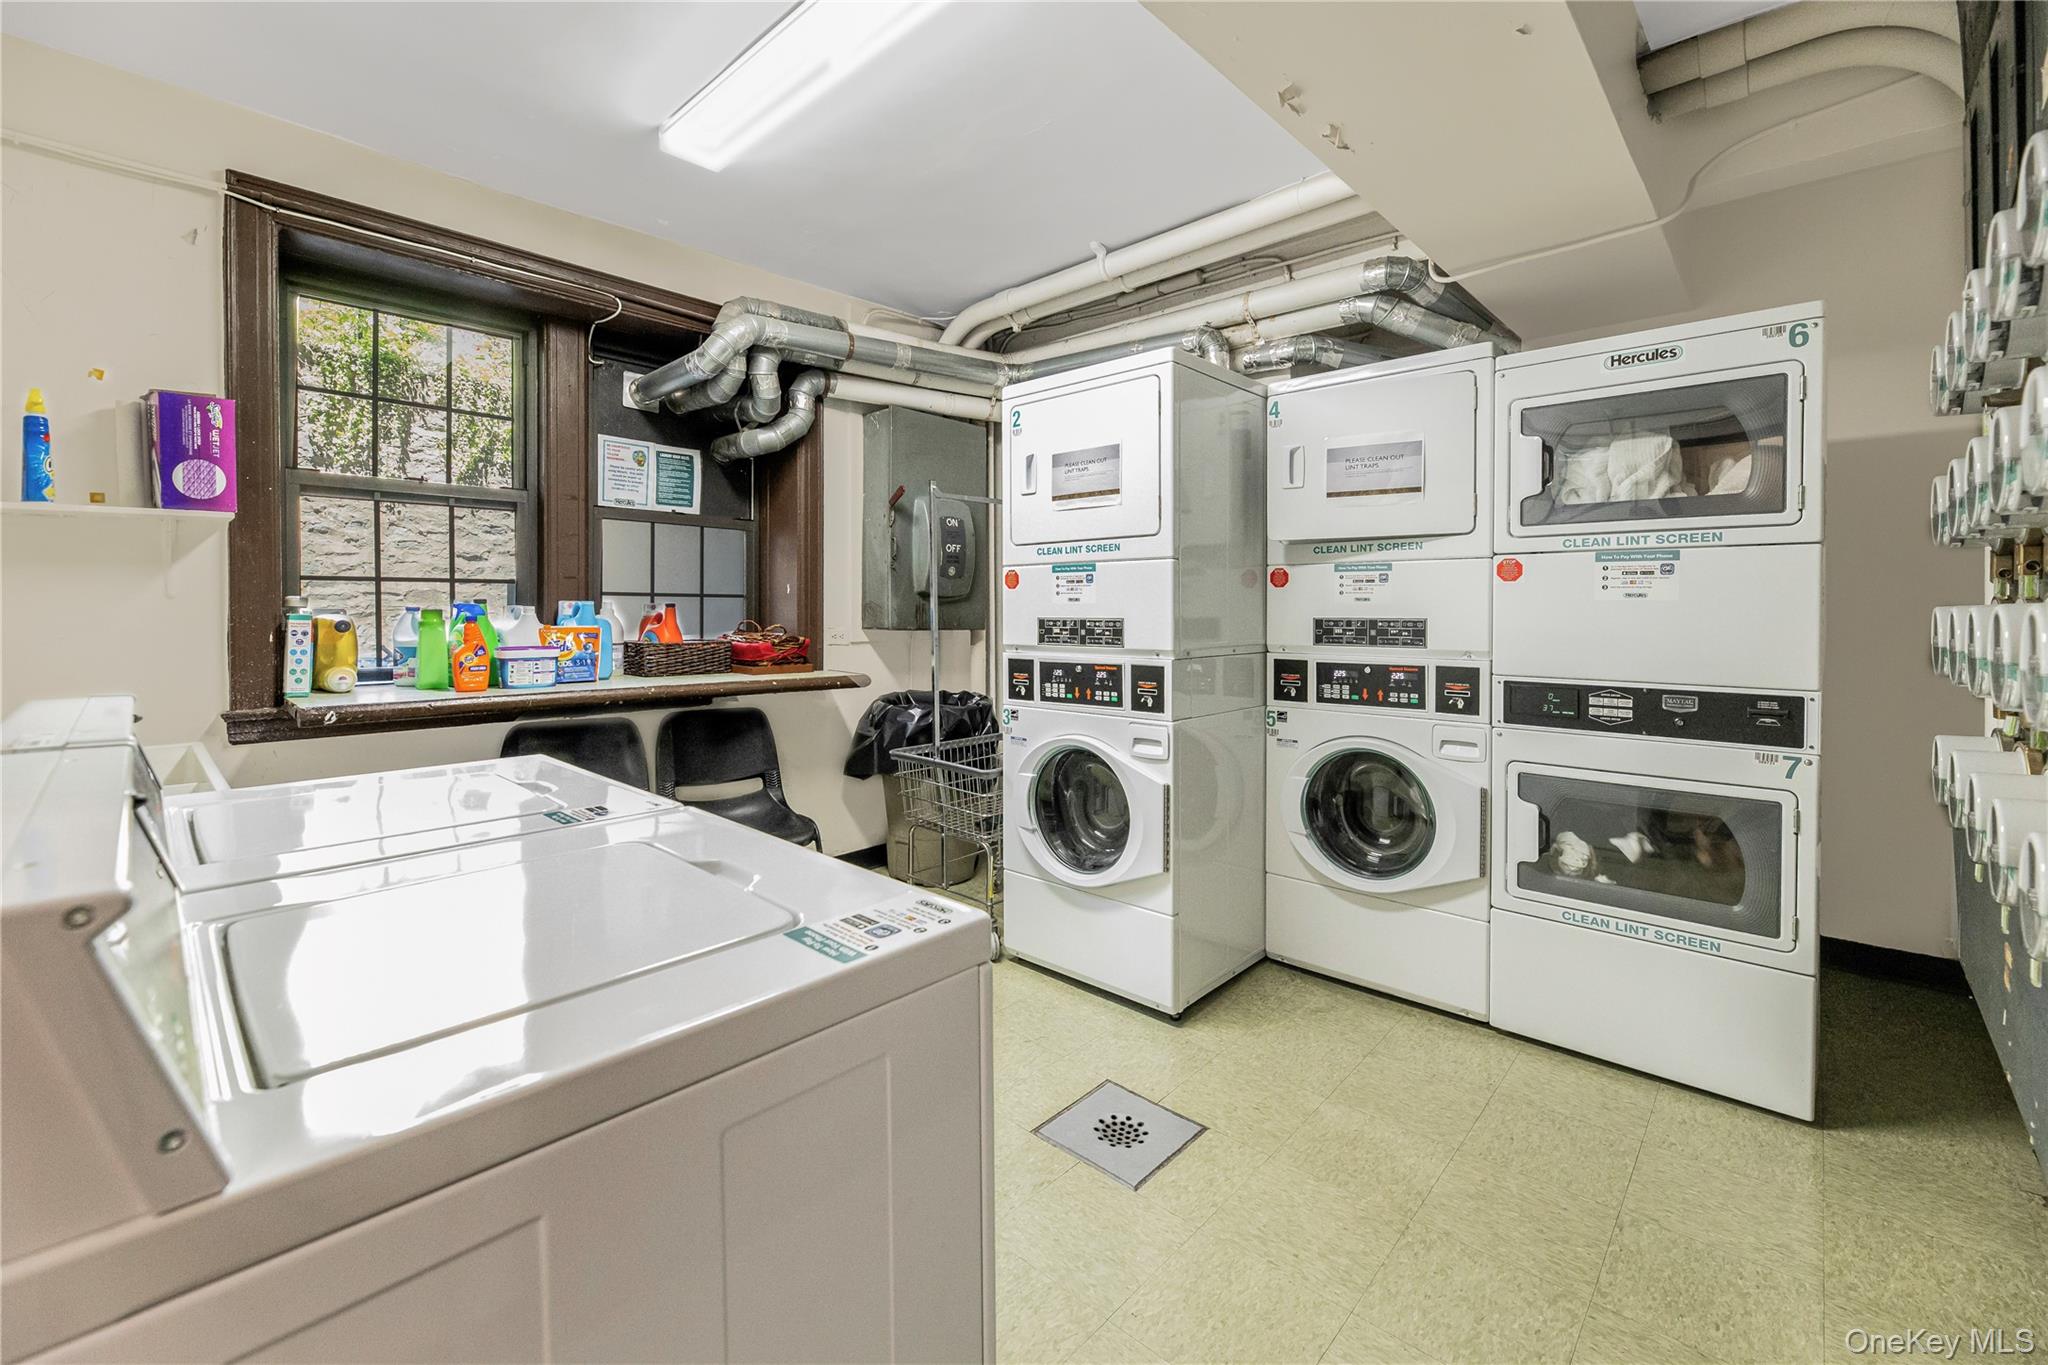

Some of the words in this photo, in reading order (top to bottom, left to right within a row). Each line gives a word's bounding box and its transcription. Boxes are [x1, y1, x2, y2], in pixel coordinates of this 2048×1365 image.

[1789, 322, 1810, 348] 6
[1610, 347, 1678, 368] Hercules
[1269, 400, 1280, 418] 4
[1012, 410, 1021, 428] 2
[1081, 458, 1096, 466] CLEAN
[1097, 456, 1107, 464] OUT
[946, 518, 959, 527] ON
[945, 543, 961, 553] OFF
[1312, 544, 1348, 555] CLEAN
[1350, 543, 1375, 554] LINT
[1377, 541, 1423, 552] SCREEN
[1562, 536, 1611, 549] CLEAN
[1616, 535, 1651, 546] LINT
[1655, 531, 1723, 544] SCREEN
[1037, 546, 1063, 556] CLEAN
[1065, 545, 1083, 555] LINT
[1086, 543, 1121, 554] SCREEN
[1003, 708, 1010, 725] 3
[1542, 704, 1554, 712] 37
[1266, 710, 1276, 727] 5
[1782, 755, 1802, 780] 7
[1561, 911, 1610, 929] CLEAN
[1615, 921, 1649, 937] LINT
[1654, 929, 1721, 953] SCREEN
